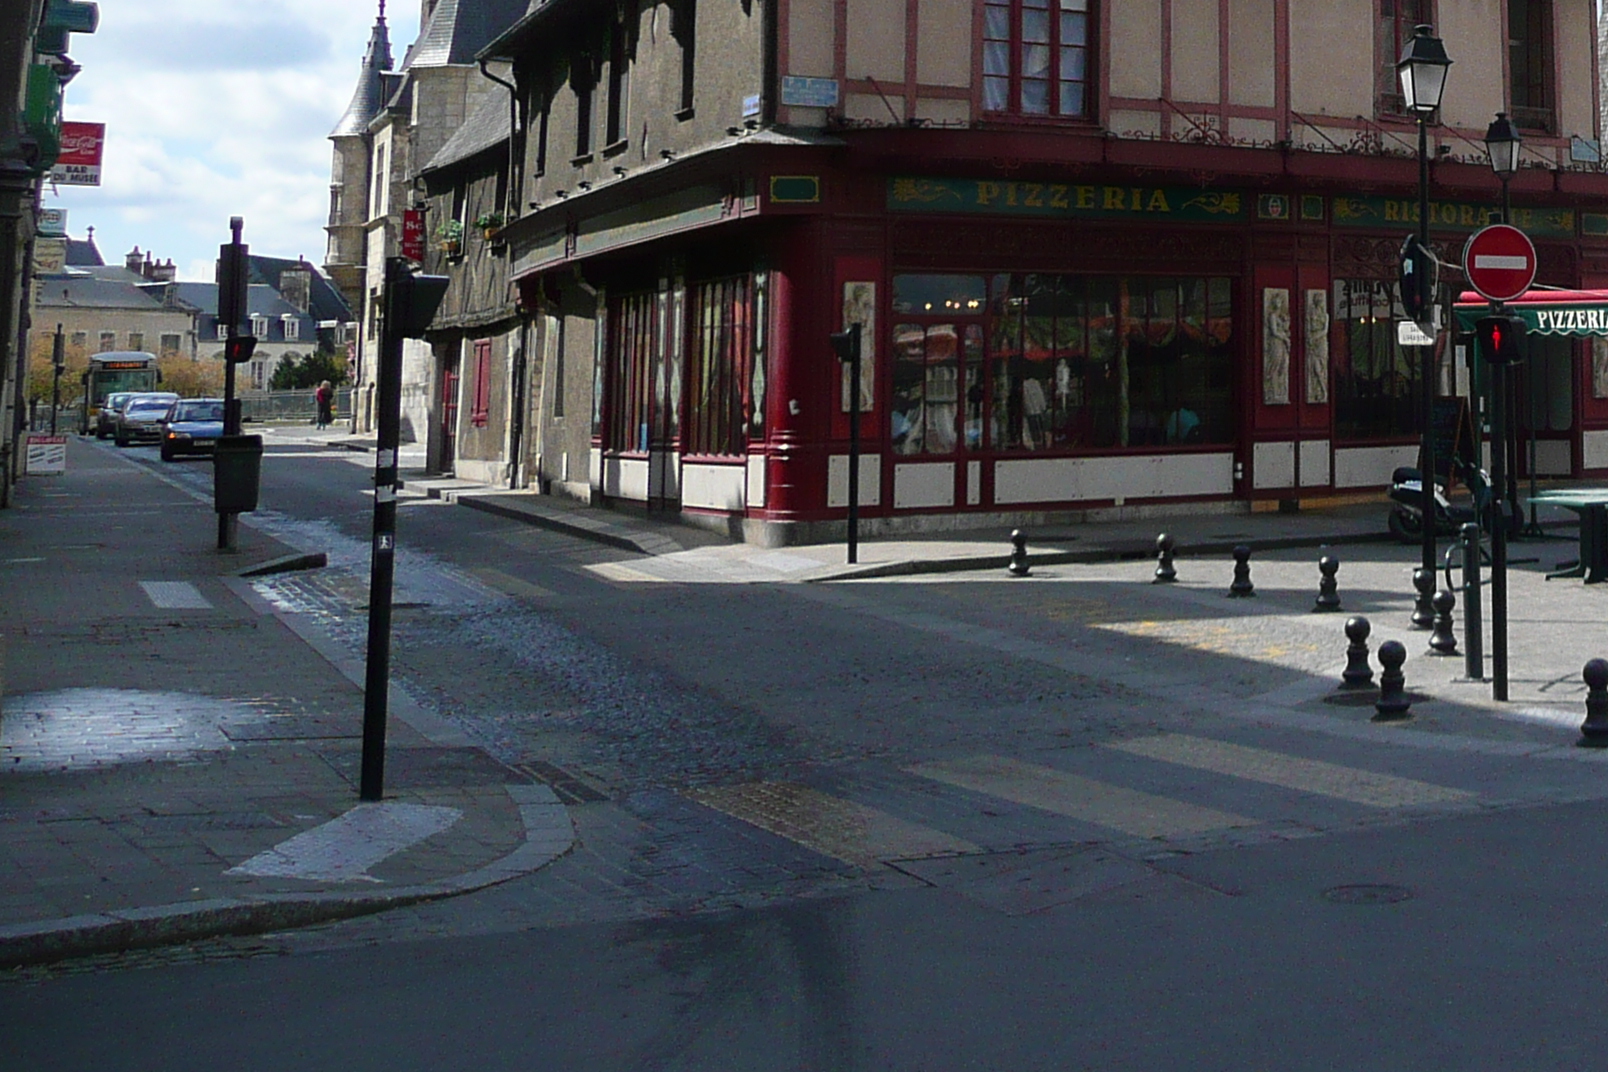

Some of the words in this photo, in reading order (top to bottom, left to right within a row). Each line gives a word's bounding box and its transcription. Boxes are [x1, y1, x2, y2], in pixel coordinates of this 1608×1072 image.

[53, 173, 66, 182] DU
[65, 165, 88, 174] BAR
[976, 180, 1171, 213] PIZZERIA
[1384, 199, 1533, 228] RISTORATE
